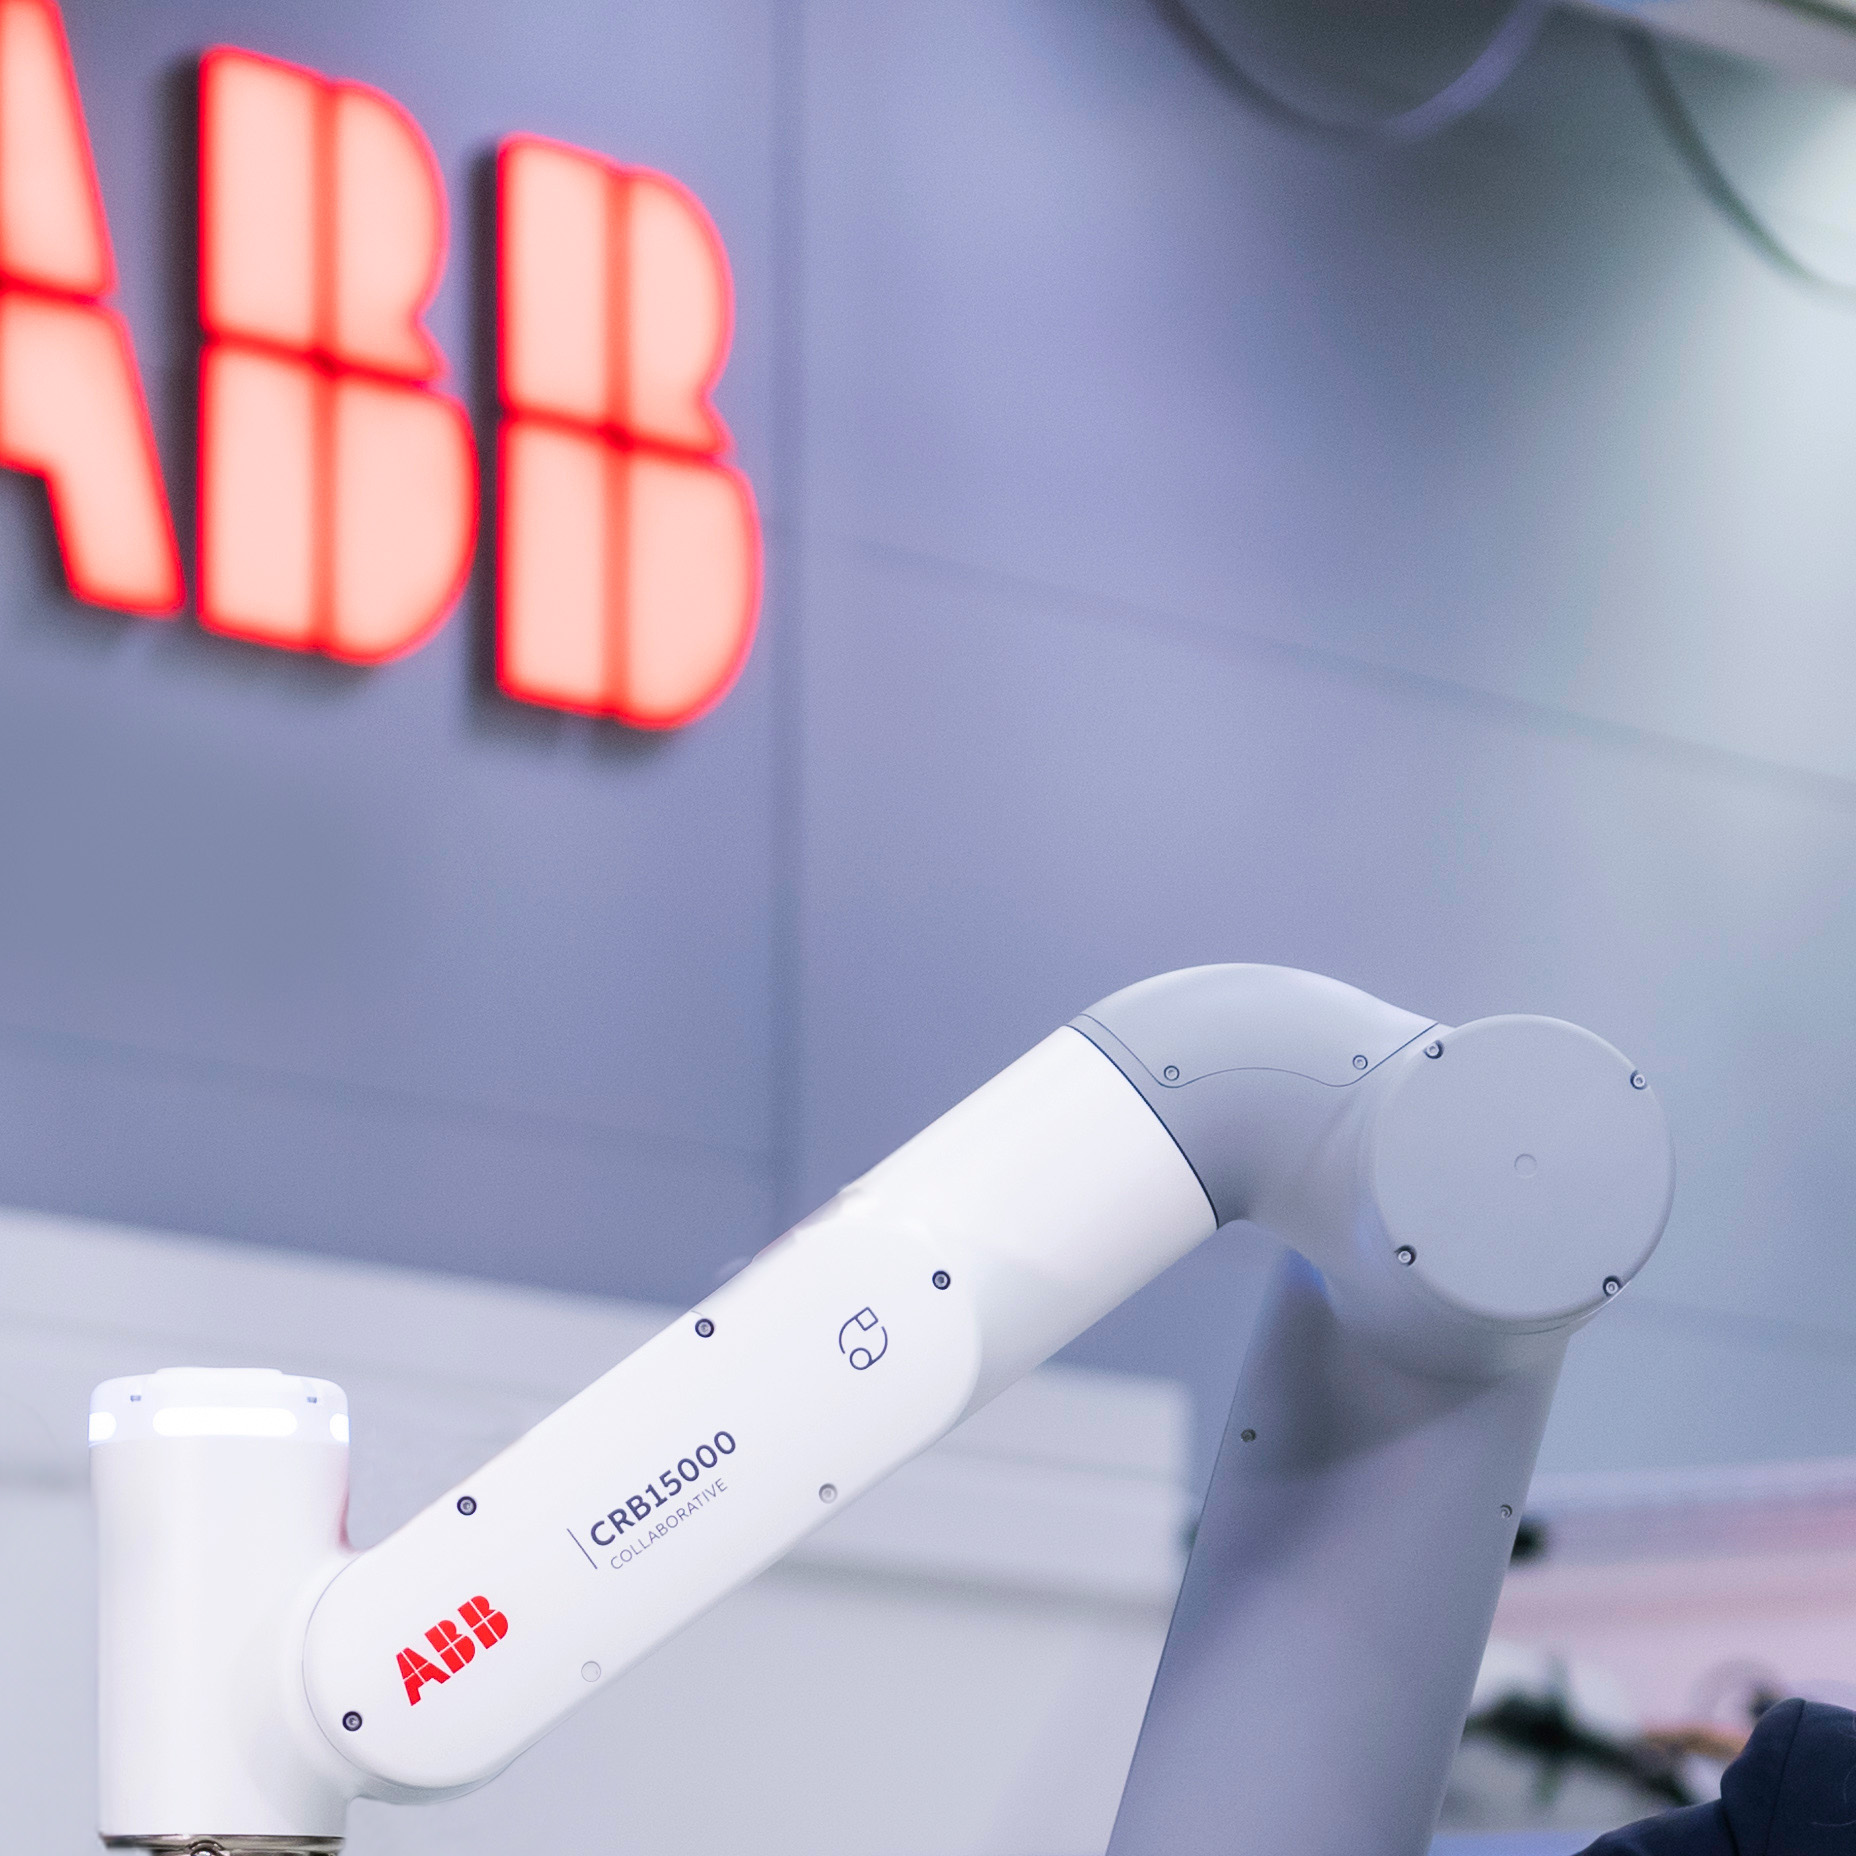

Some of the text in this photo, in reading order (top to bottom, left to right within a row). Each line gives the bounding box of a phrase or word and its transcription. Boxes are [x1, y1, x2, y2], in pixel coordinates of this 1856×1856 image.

[590, 1430, 736, 1546] CRB15000
[610, 1477, 728, 1569] COLLABORATIVE
[396, 1596, 508, 1706] ABB
